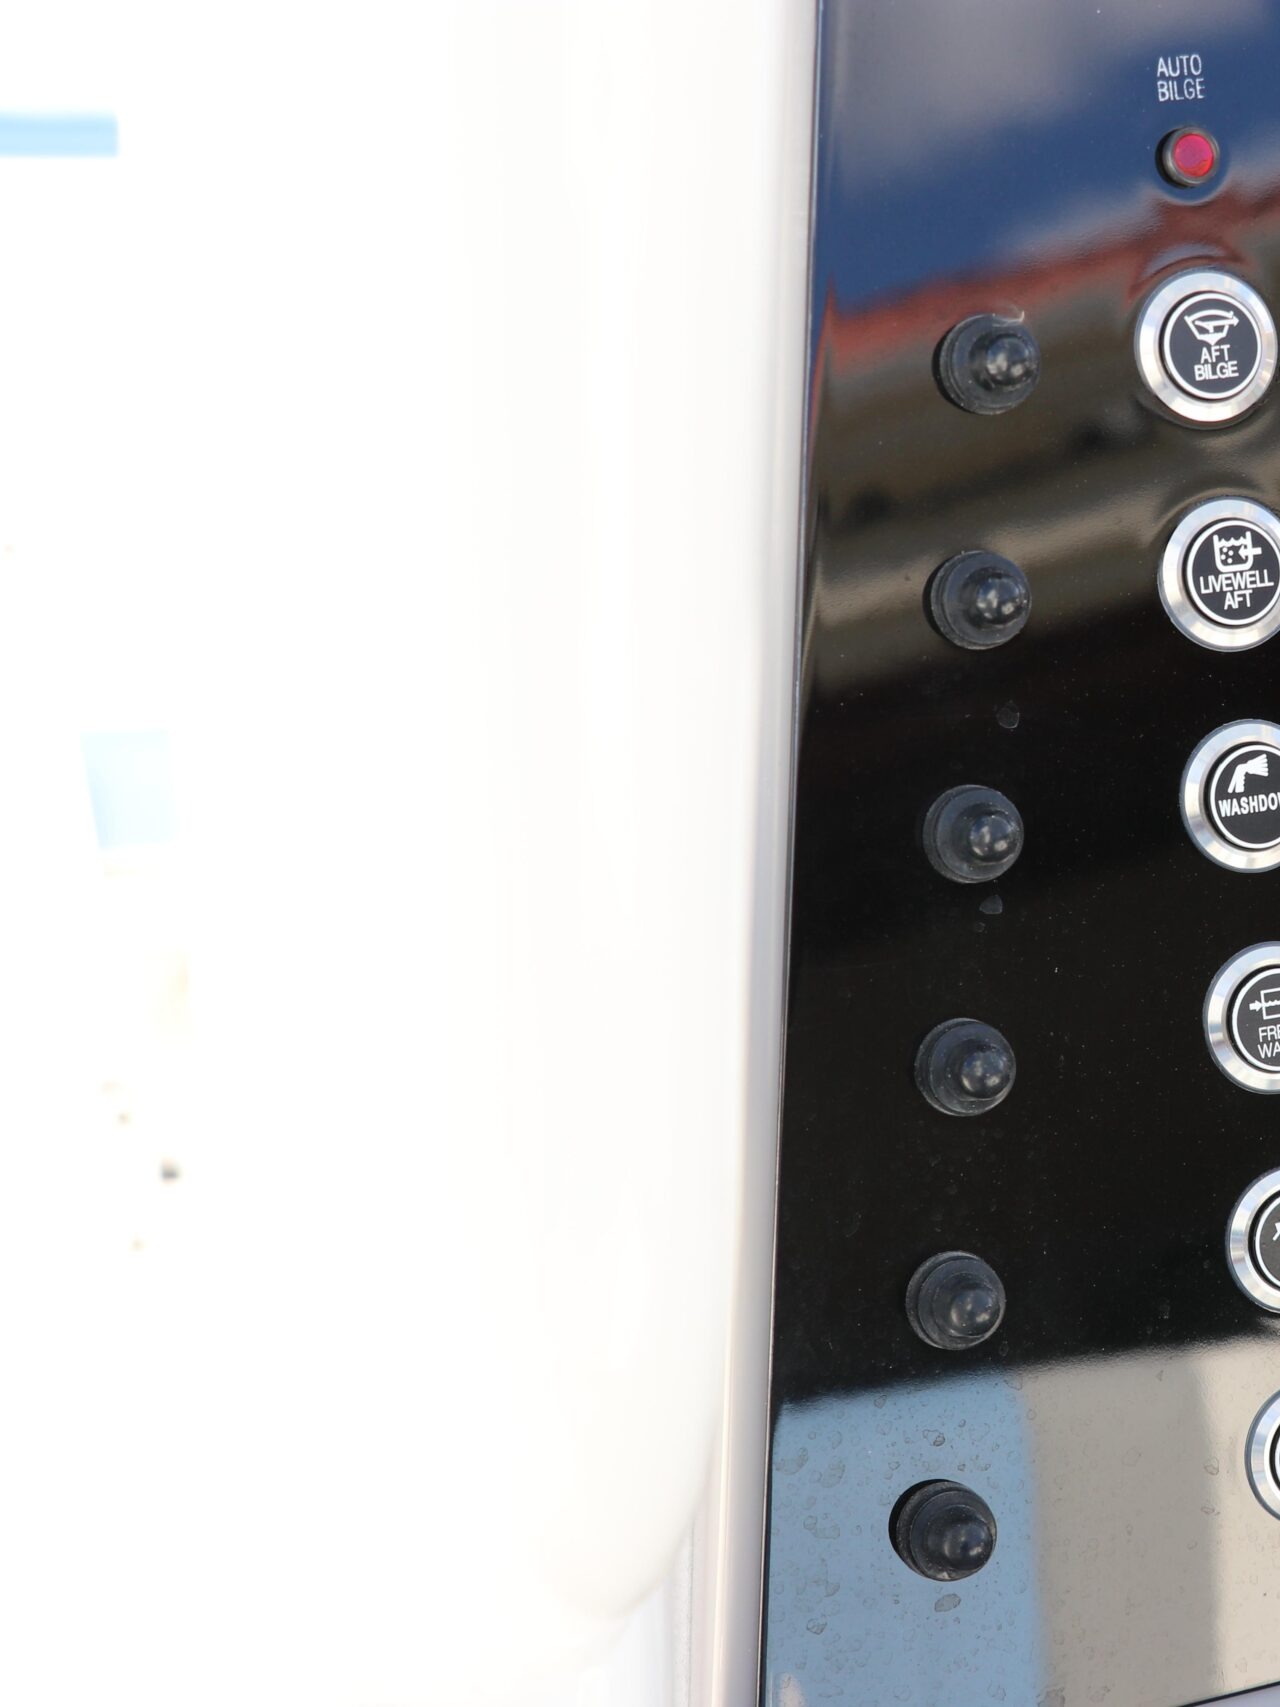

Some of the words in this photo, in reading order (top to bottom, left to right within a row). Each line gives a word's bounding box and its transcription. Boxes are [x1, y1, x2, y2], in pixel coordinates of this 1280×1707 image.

[1157, 54, 1202, 77] AUTO
[1157, 78, 1205, 101] BILGE
[1201, 344, 1230, 364] AFT
[1194, 361, 1239, 381] BILGE
[1200, 569, 1274, 594] LIVEWELL
[1224, 590, 1253, 610] AFT
